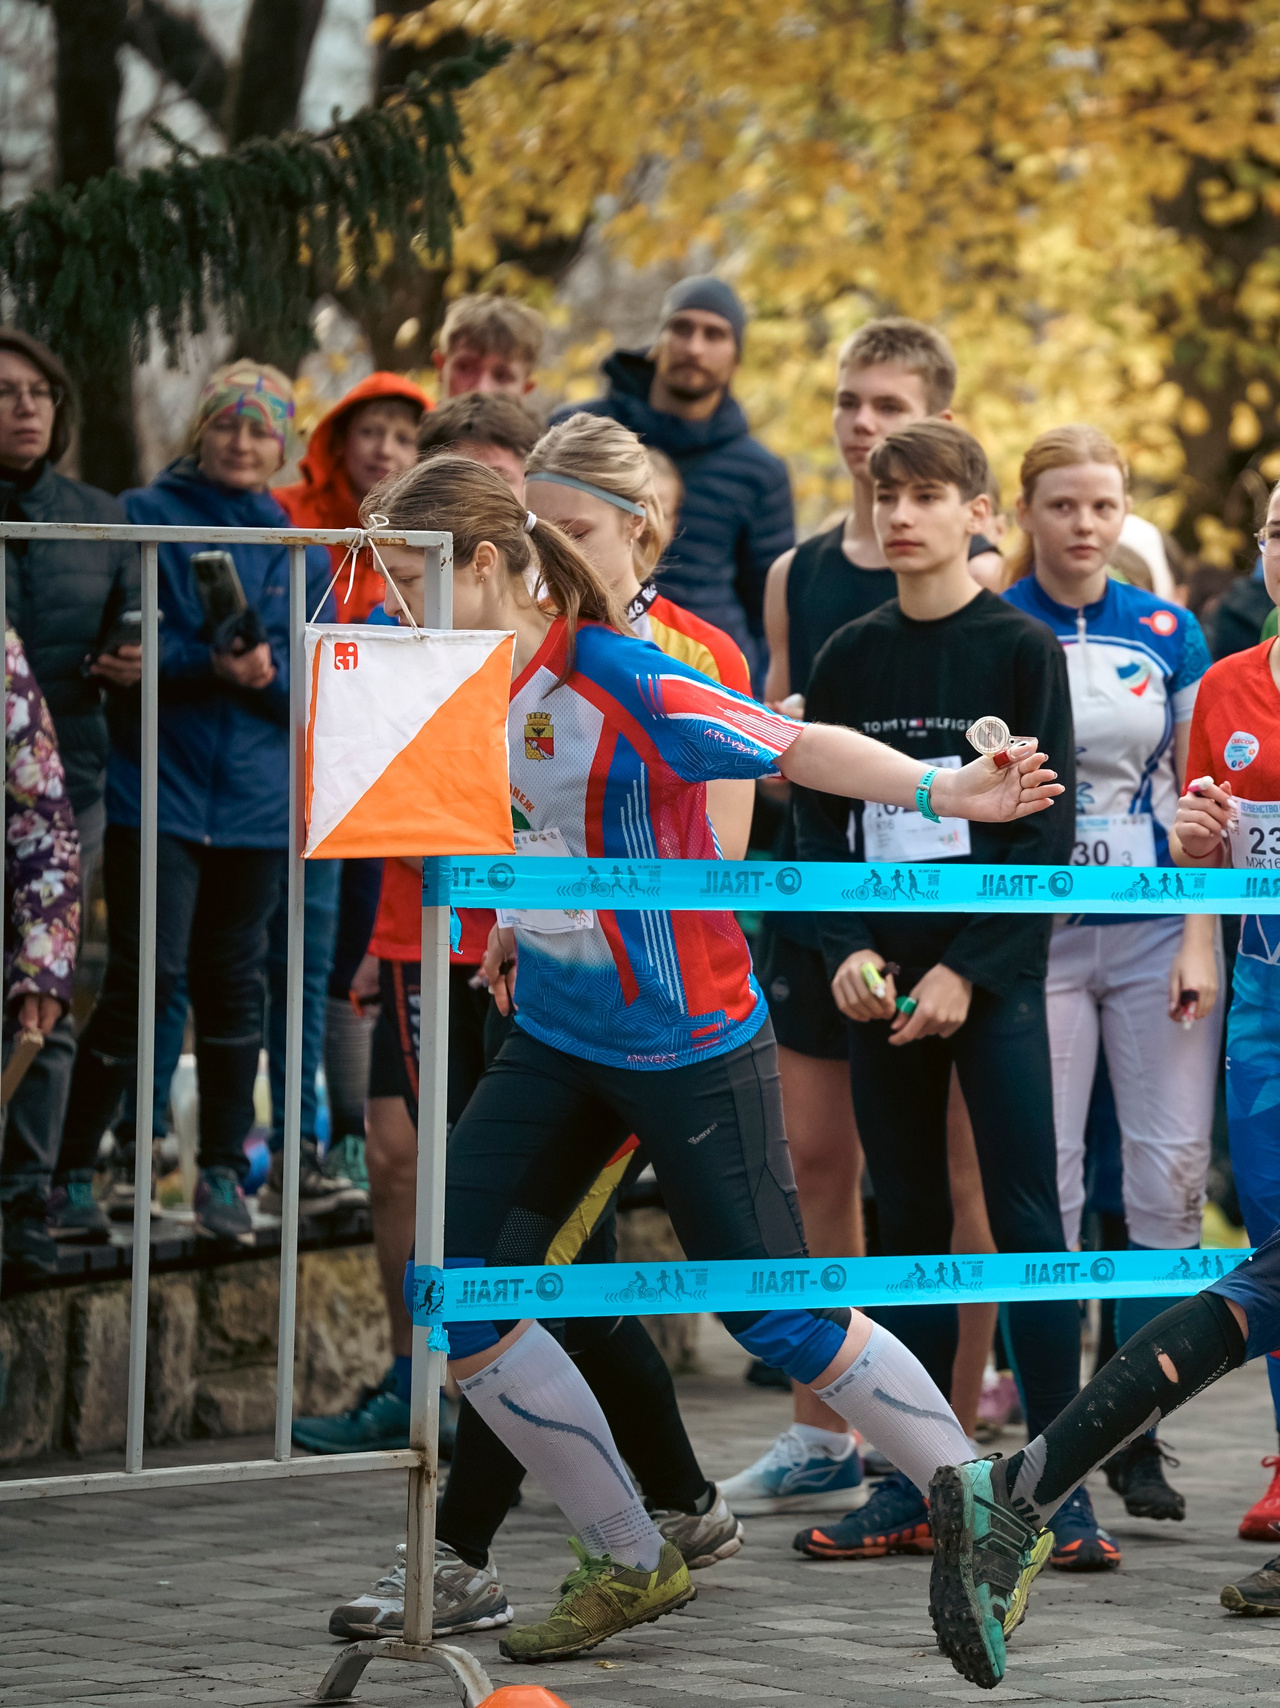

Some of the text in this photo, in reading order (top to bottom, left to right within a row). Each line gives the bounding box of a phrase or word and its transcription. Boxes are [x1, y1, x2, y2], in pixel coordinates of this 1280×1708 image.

[863, 717, 907, 733] TOMMY
[510, 782, 535, 813] НЕЖ
[1240, 801, 1278, 814] ПЕРВЕНСТВО
[1121, 850, 1133, 868] 3
